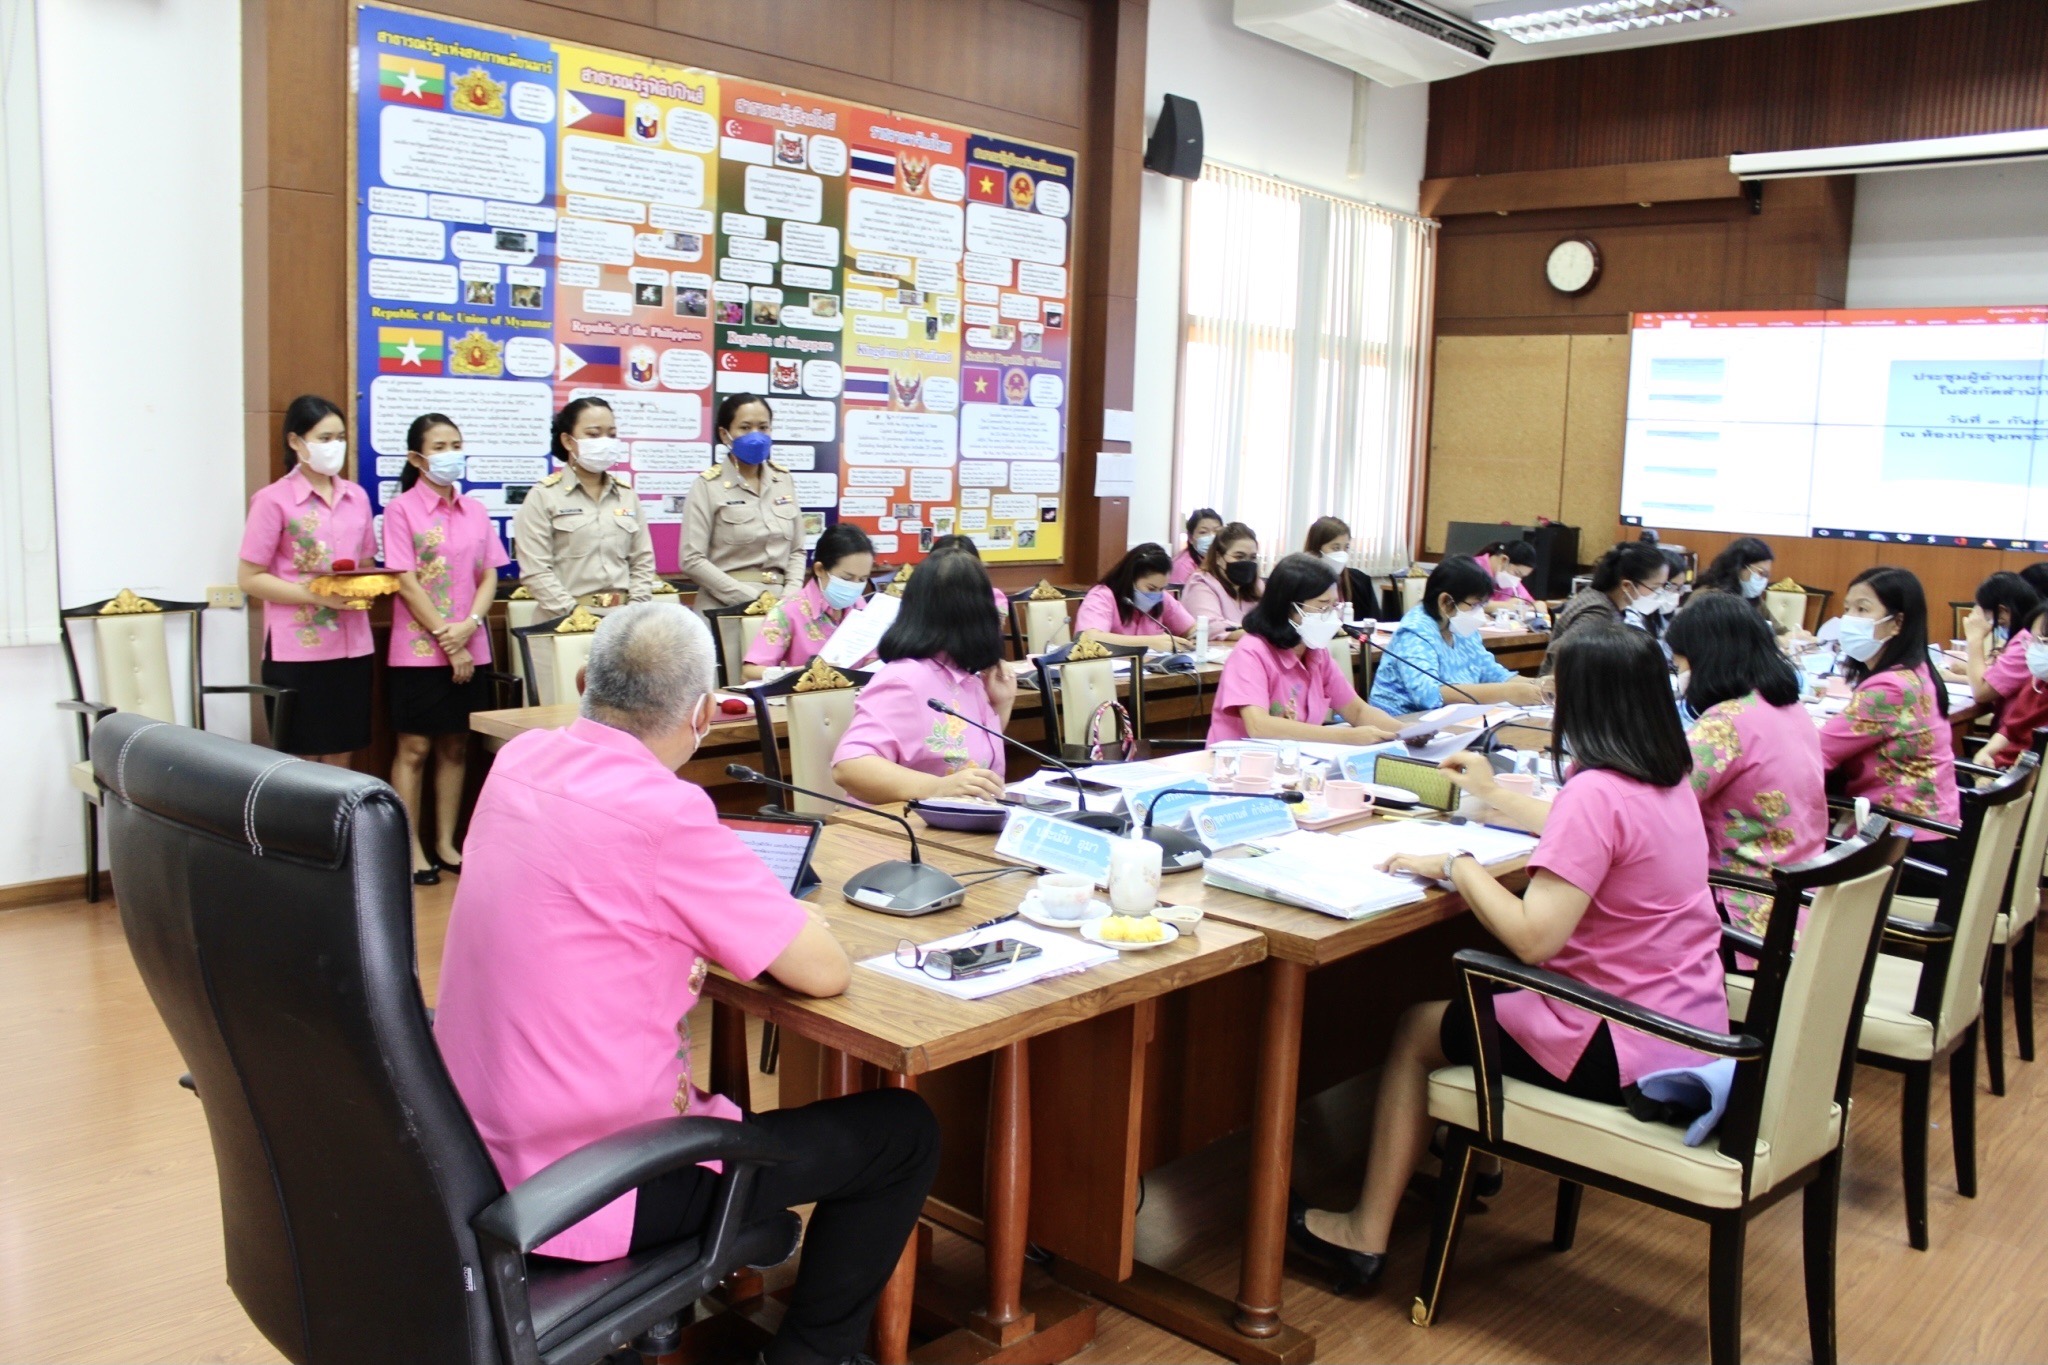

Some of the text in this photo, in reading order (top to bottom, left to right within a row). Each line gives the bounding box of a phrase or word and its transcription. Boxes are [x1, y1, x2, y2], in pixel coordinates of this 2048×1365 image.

[371, 306, 553, 330] Republic of the Union of Myanmar
[571, 319, 703, 341] Republic of the Philippines
[726, 331, 772, 347] Republic
[773, 335, 785, 347] of
[785, 335, 835, 353] Singapore
[856, 342, 899, 360] Kingdom
[900, 346, 911, 360] of
[912, 348, 953, 364] Thailand
[995, 352, 1026, 366] Republic
